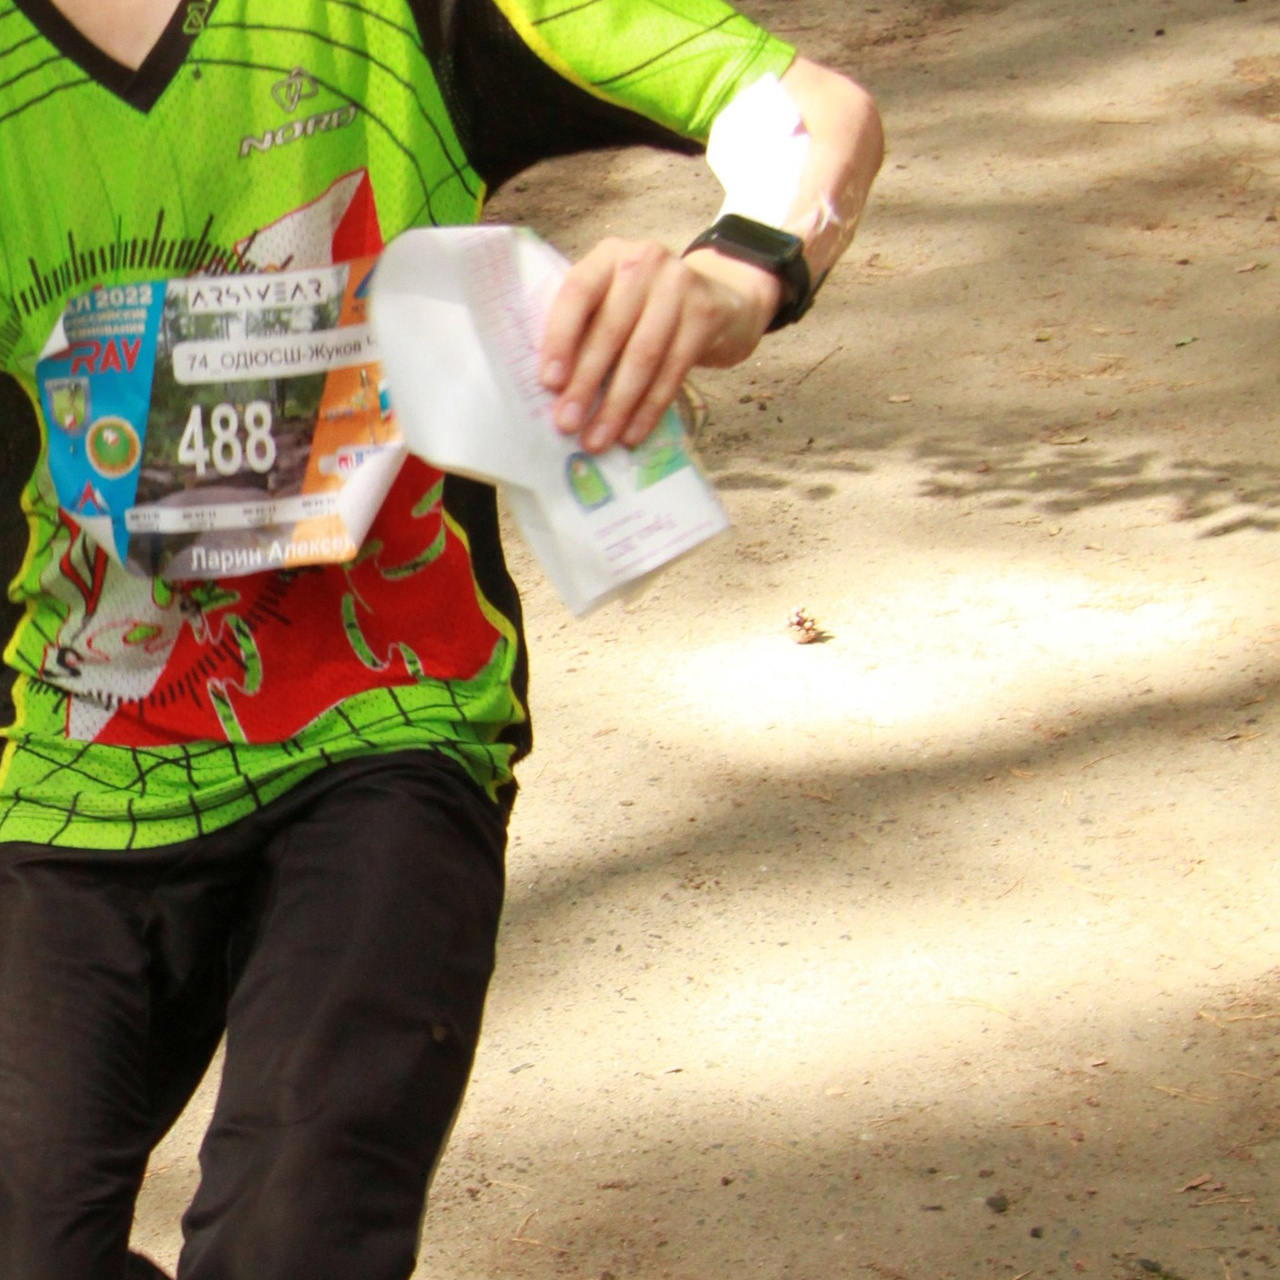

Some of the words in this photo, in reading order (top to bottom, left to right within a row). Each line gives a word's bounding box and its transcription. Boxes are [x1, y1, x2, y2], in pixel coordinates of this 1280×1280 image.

[238, 102, 359, 158] NORD
[94, 283, 153, 309] 2022
[192, 278, 322, 308] ARSWEAR
[178, 401, 276, 477] 488
